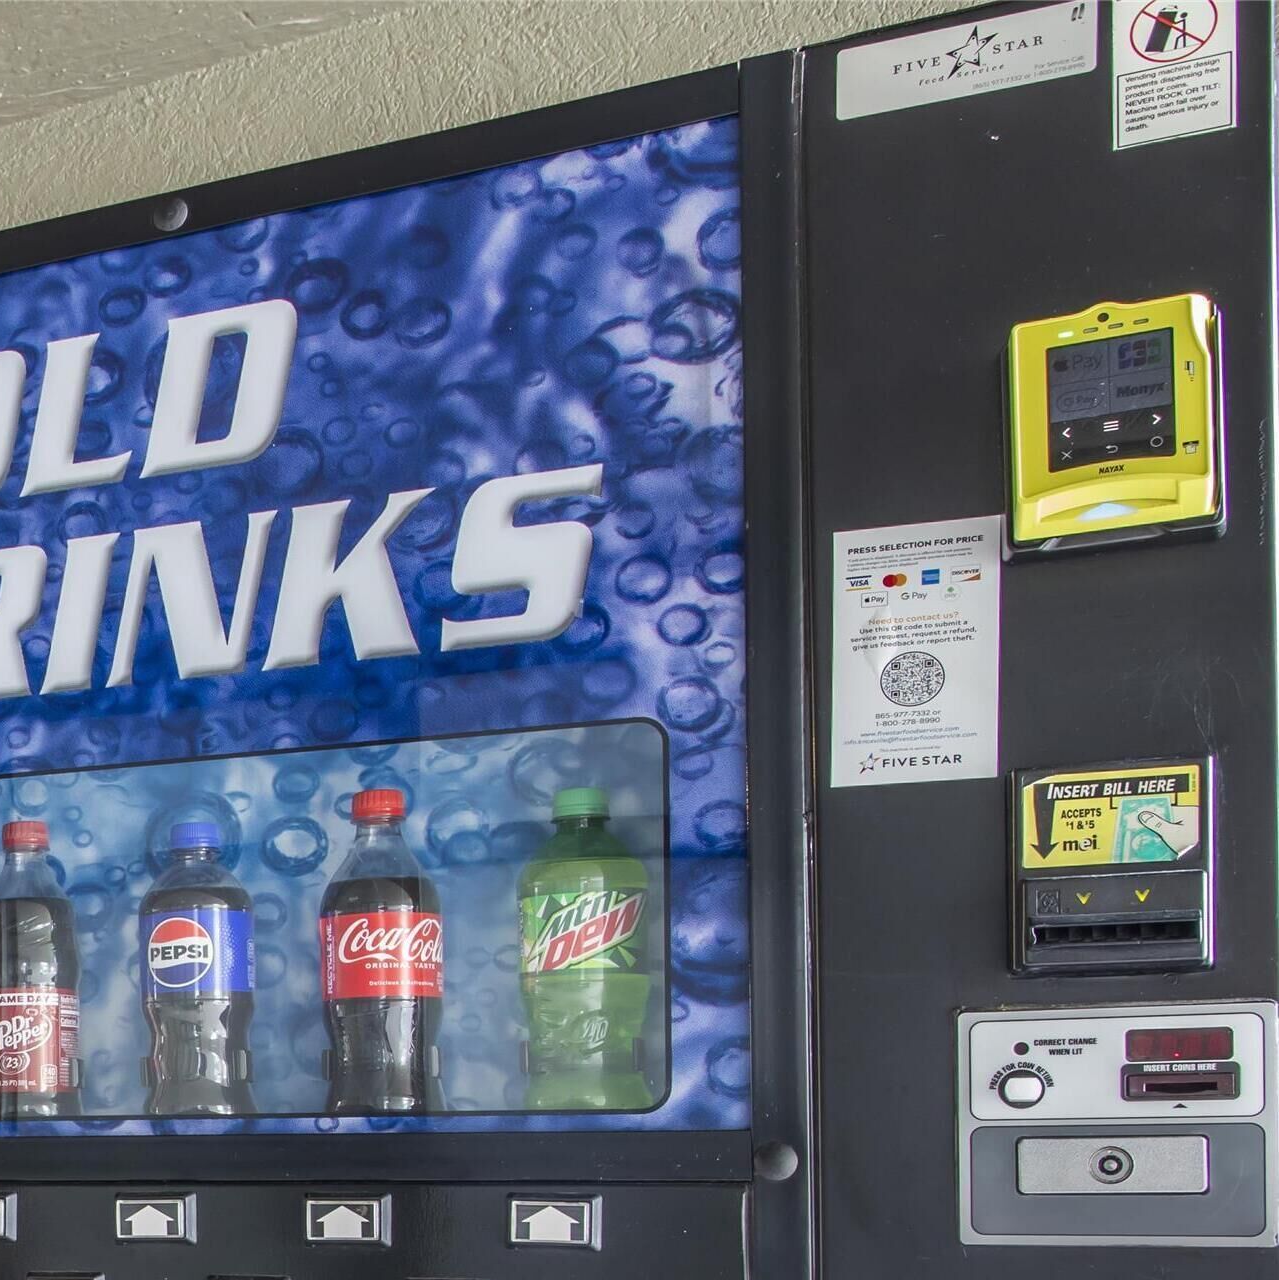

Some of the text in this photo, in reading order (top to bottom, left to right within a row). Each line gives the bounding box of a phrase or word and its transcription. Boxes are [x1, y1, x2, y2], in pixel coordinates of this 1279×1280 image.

[893, 35, 1044, 75] FIVE STAR
[956, 63, 1005, 78] Service
[1125, 58, 1221, 83] Vending machine design
[1125, 66, 1220, 92] prevents dispensing free
[1125, 88, 1155, 100] product
[1125, 96, 1155, 108] NEVER
[1157, 91, 1183, 101] ROCK
[1185, 87, 1199, 95] OR
[1125, 104, 1158, 116] Machine
[1159, 101, 1174, 109] can
[1176, 97, 1188, 106] fall
[1125, 114, 1155, 125] causing
[1156, 108, 1185, 118] serious
[1187, 102, 1208, 112] injury
[1125, 124, 1148, 132] death.
[1099, 464, 1125, 474] NAYAX
[847, 534, 985, 556] PRESS SELECTION FOR PRICE
[849, 579, 870, 588] VISA
[870, 595, 885, 605] Pay
[912, 591, 928, 601] Pay
[868, 611, 960, 626] Need to contact us?
[859, 627, 873, 635] Use
[875, 624, 889, 633] this
[891, 624, 902, 632] QR
[904, 622, 923, 631] code
[935, 619, 962, 629] submit
[850, 635, 877, 643] service
[911, 629, 941, 640] request
[852, 643, 869, 651] give
[870, 642, 879, 650] us
[880, 639, 914, 648] feedback
[926, 636, 951, 647] report
[875, 710, 931, 720] 865-977-7332
[875, 717, 941, 728] 1-800-278-8990
[882, 754, 963, 768] FIVE STAR
[1047, 783, 1099, 800] INSERT
[1103, 781, 1133, 796] BILL
[1138, 778, 1177, 794] HERE
[1060, 807, 1102, 820] ACCEPTS
[1062, 834, 1098, 852] mei
[150, 944, 209, 962] PEPSI
[414, 962, 436, 970] TASTE
[12, 1015, 34, 1031] Dr
[1033, 1036, 1098, 1048] CORRECT CHANGE
[1048, 1047, 1083, 1056] WHEN LIT
[6, 1056, 19, 1068] 23
[1143, 1062, 1218, 1072] INSERT COINS HERE
[989, 1061, 1056, 1091] PRESS FOR COIN RETURN
